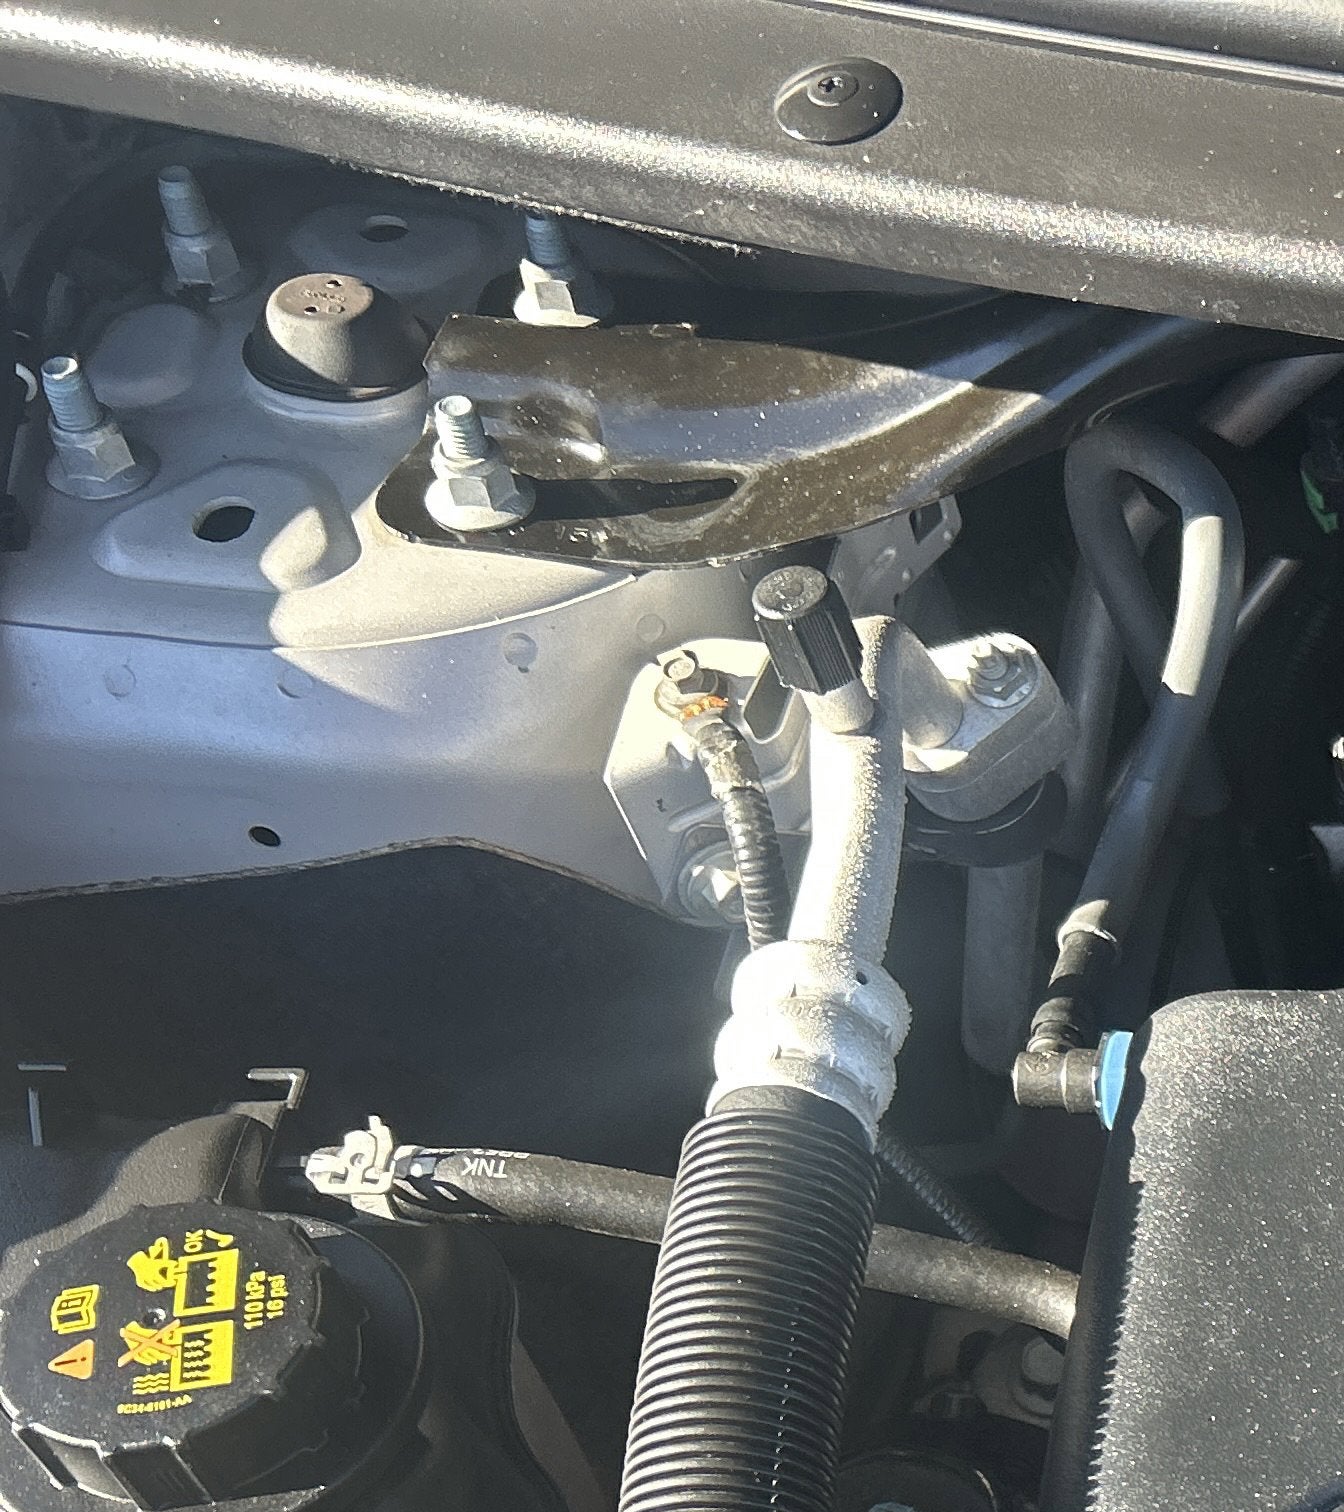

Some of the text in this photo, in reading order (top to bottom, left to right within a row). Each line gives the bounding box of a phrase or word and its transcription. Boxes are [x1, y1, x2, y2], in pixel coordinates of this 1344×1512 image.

[461, 1157, 508, 1179] TNK
[184, 1229, 204, 1253] OK
[244, 1270, 266, 1330] 110 kPa
[266, 1274, 289, 1320] 16 psi
